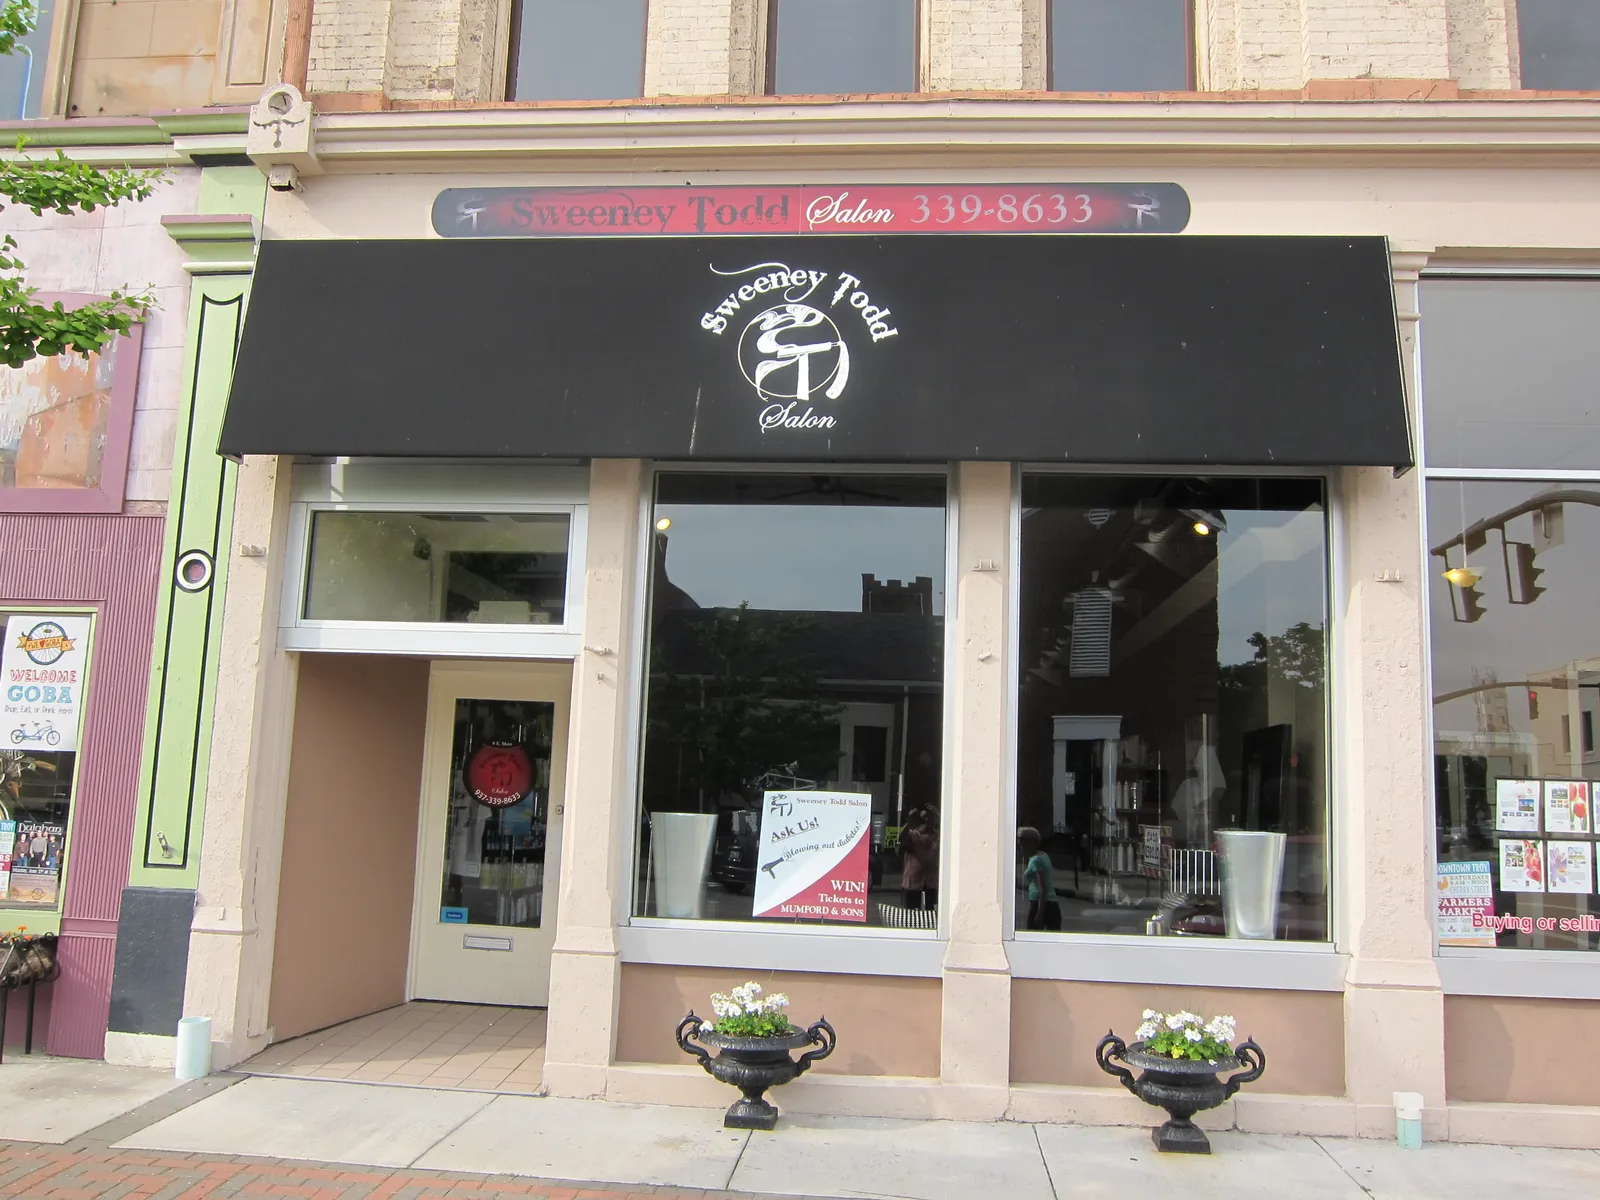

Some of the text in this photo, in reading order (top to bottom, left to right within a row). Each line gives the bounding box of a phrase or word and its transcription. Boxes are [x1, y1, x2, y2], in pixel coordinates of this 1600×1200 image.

[509, 190, 1094, 233] Sweeney Todd Salon 339-8633
[700, 262, 899, 343] Sweeney Todd
[758, 401, 837, 433] Salon
[10, 669, 77, 683] WELCOME
[7, 685, 73, 704] GOBA
[474, 789, 521, 806] 937-339-8633
[796, 797, 868, 807] Sweeney Todd Salon
[771, 816, 821, 844] Ask Us!
[784, 843, 819, 862] Blowing
[821, 841, 835, 850] out
[1471, 863, 1488, 873] TROY
[831, 879, 865, 893] WIN!
[818, 893, 865, 905] Tickets to
[1438, 898, 1491, 907] FARMERS
[781, 904, 865, 918] MUMFORD & SONS
[1472, 912, 1533, 934] Buying
[1536, 916, 1557, 931] or
